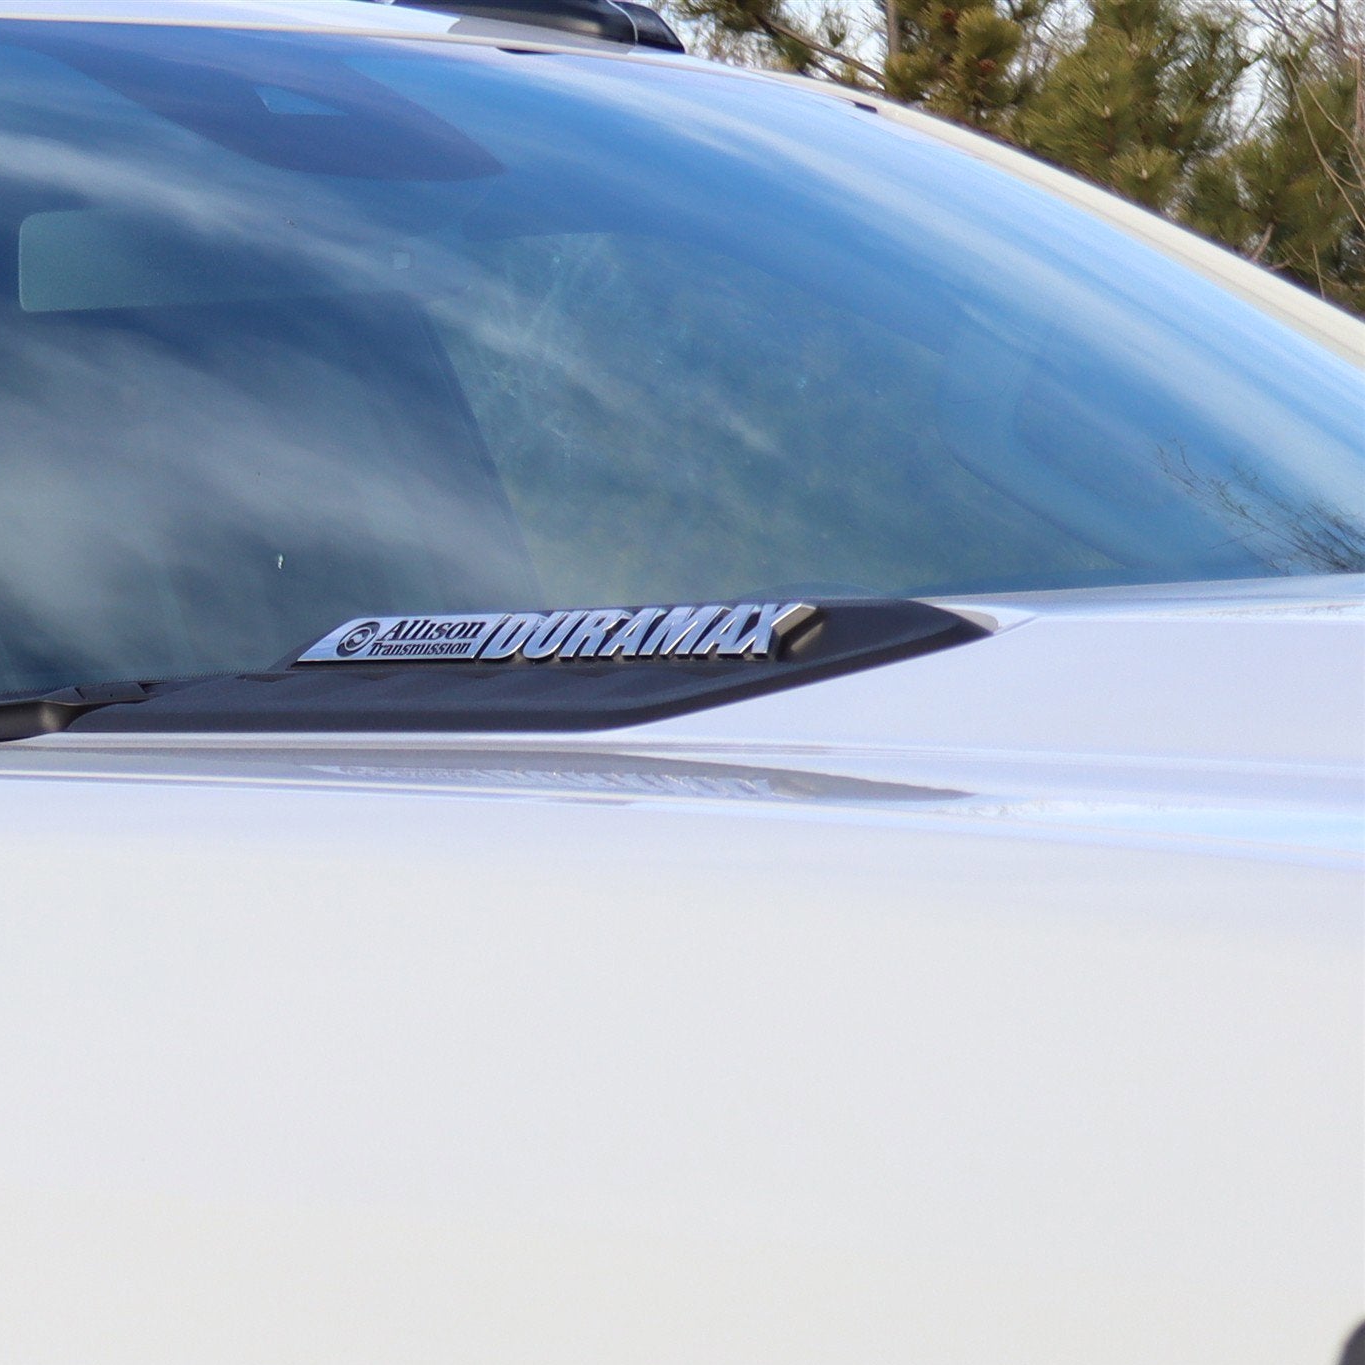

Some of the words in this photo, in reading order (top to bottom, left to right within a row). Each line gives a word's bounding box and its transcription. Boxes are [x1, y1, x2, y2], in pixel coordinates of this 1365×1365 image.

[376, 619, 486, 641] Allison
[470, 603, 812, 659] DURAMAX
[366, 642, 472, 656] Transmission
